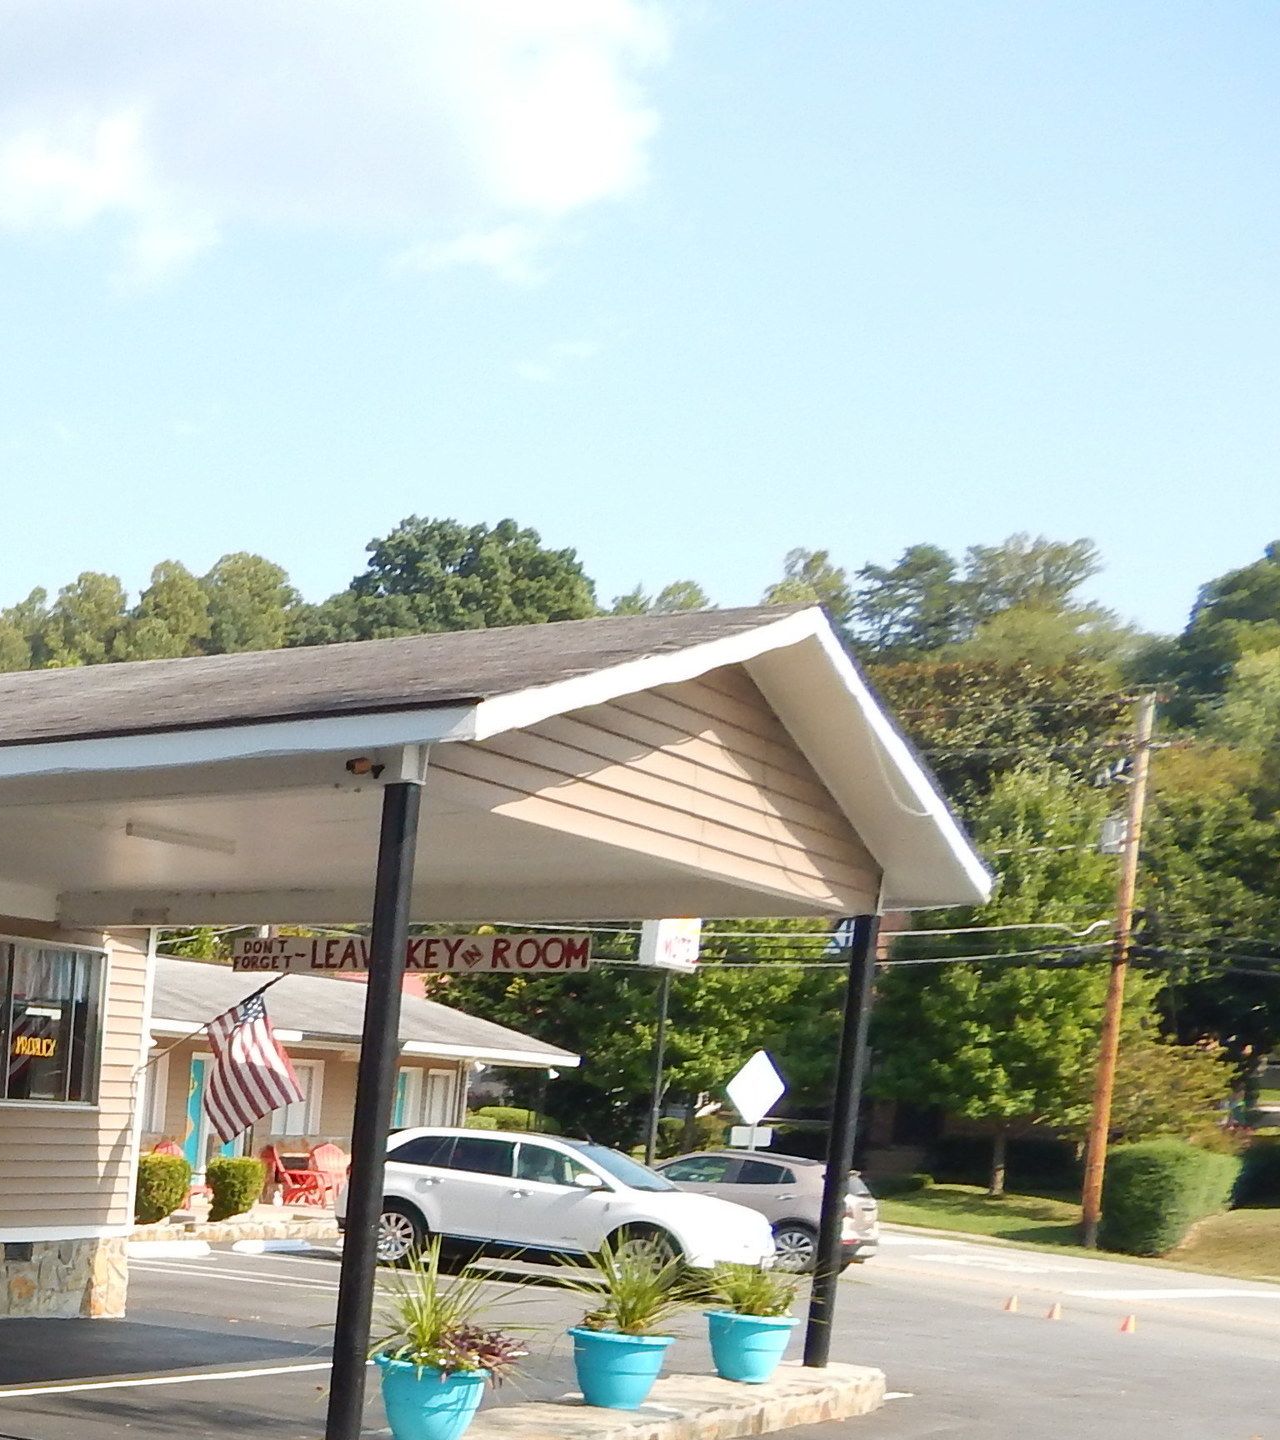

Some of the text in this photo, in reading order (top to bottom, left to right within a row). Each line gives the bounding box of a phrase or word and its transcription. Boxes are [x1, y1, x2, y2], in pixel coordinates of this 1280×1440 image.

[233, 955, 291, 969] FORGET
[405, 937, 464, 969] KEY
[461, 944, 484, 968] IN
[491, 937, 590, 969] ROOM
